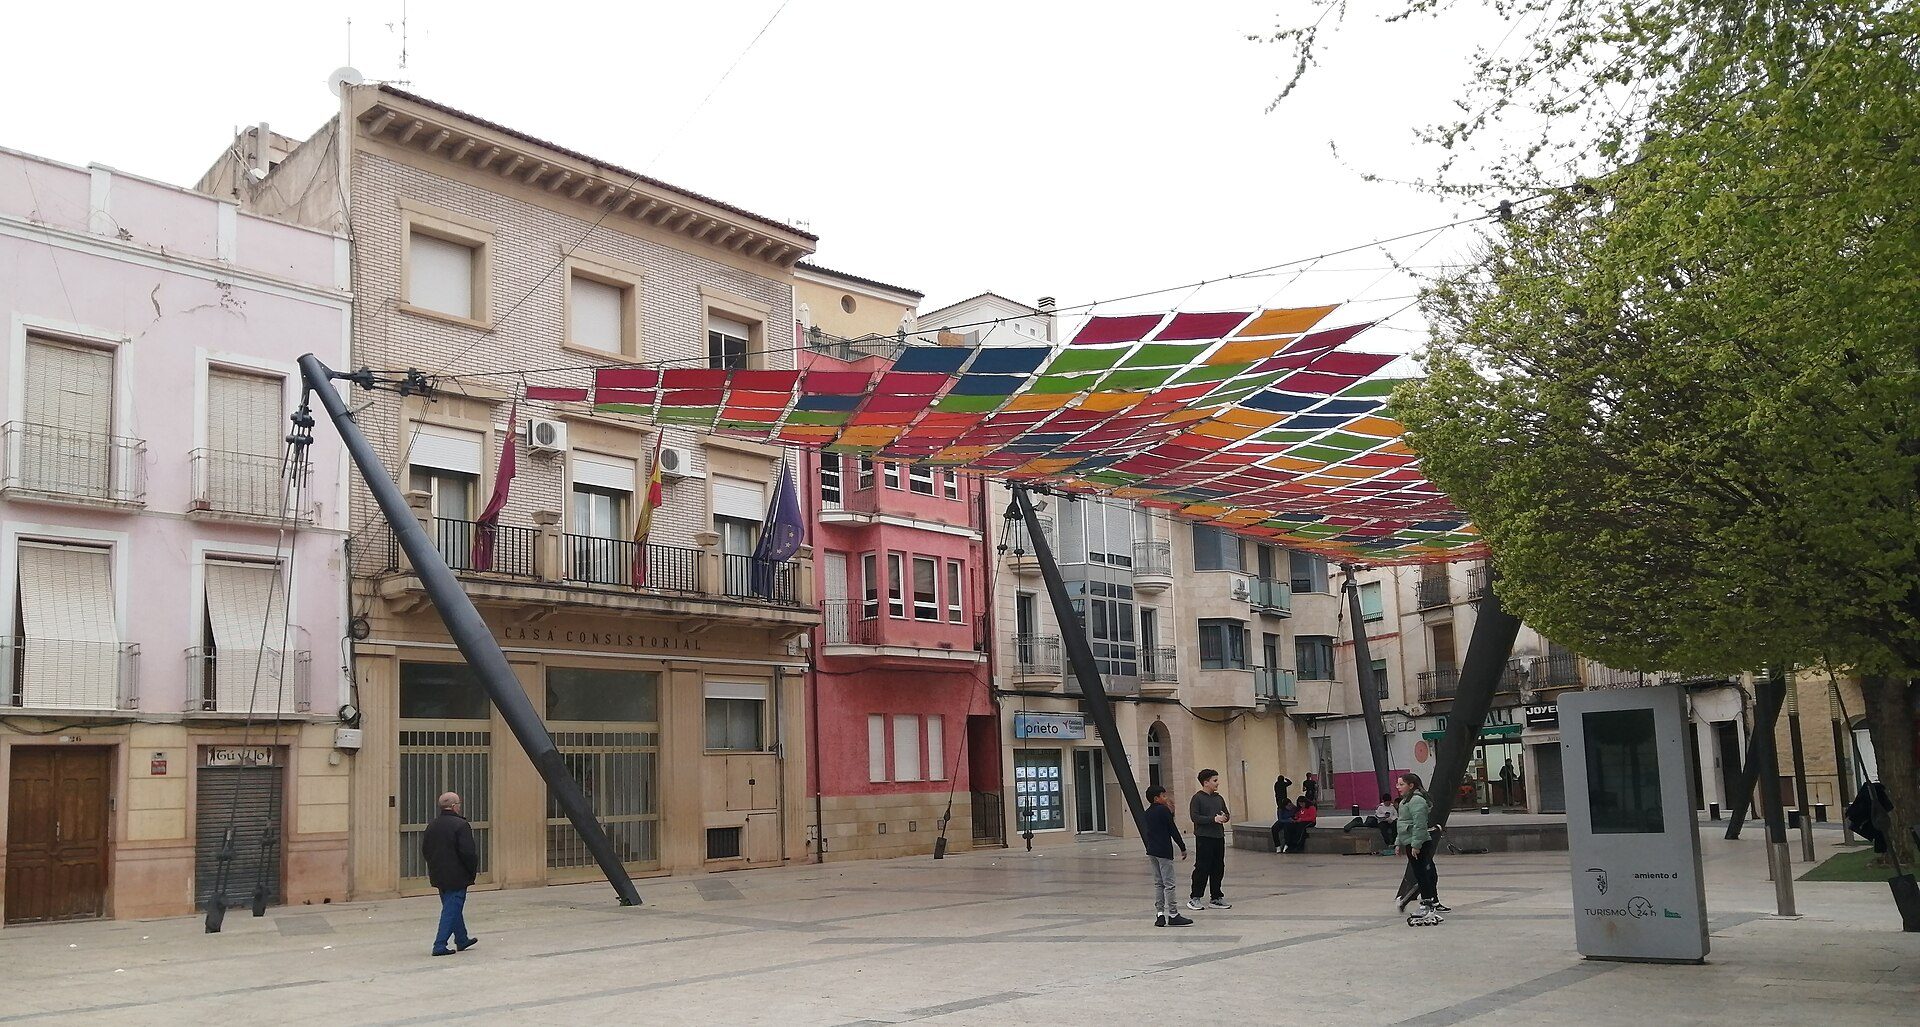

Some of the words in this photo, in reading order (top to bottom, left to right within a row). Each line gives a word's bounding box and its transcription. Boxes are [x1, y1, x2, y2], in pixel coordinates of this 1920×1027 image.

[505, 626, 555, 641] CASA
[566, 631, 701, 650] CONSISTORIAL
[1526, 705, 1559, 715] JOYE
[1026, 722, 1058, 738] prieto
[1584, 908, 1627, 917] TURISMO
[1637, 909, 1649, 917] 24
[1650, 909, 1657, 917] h
